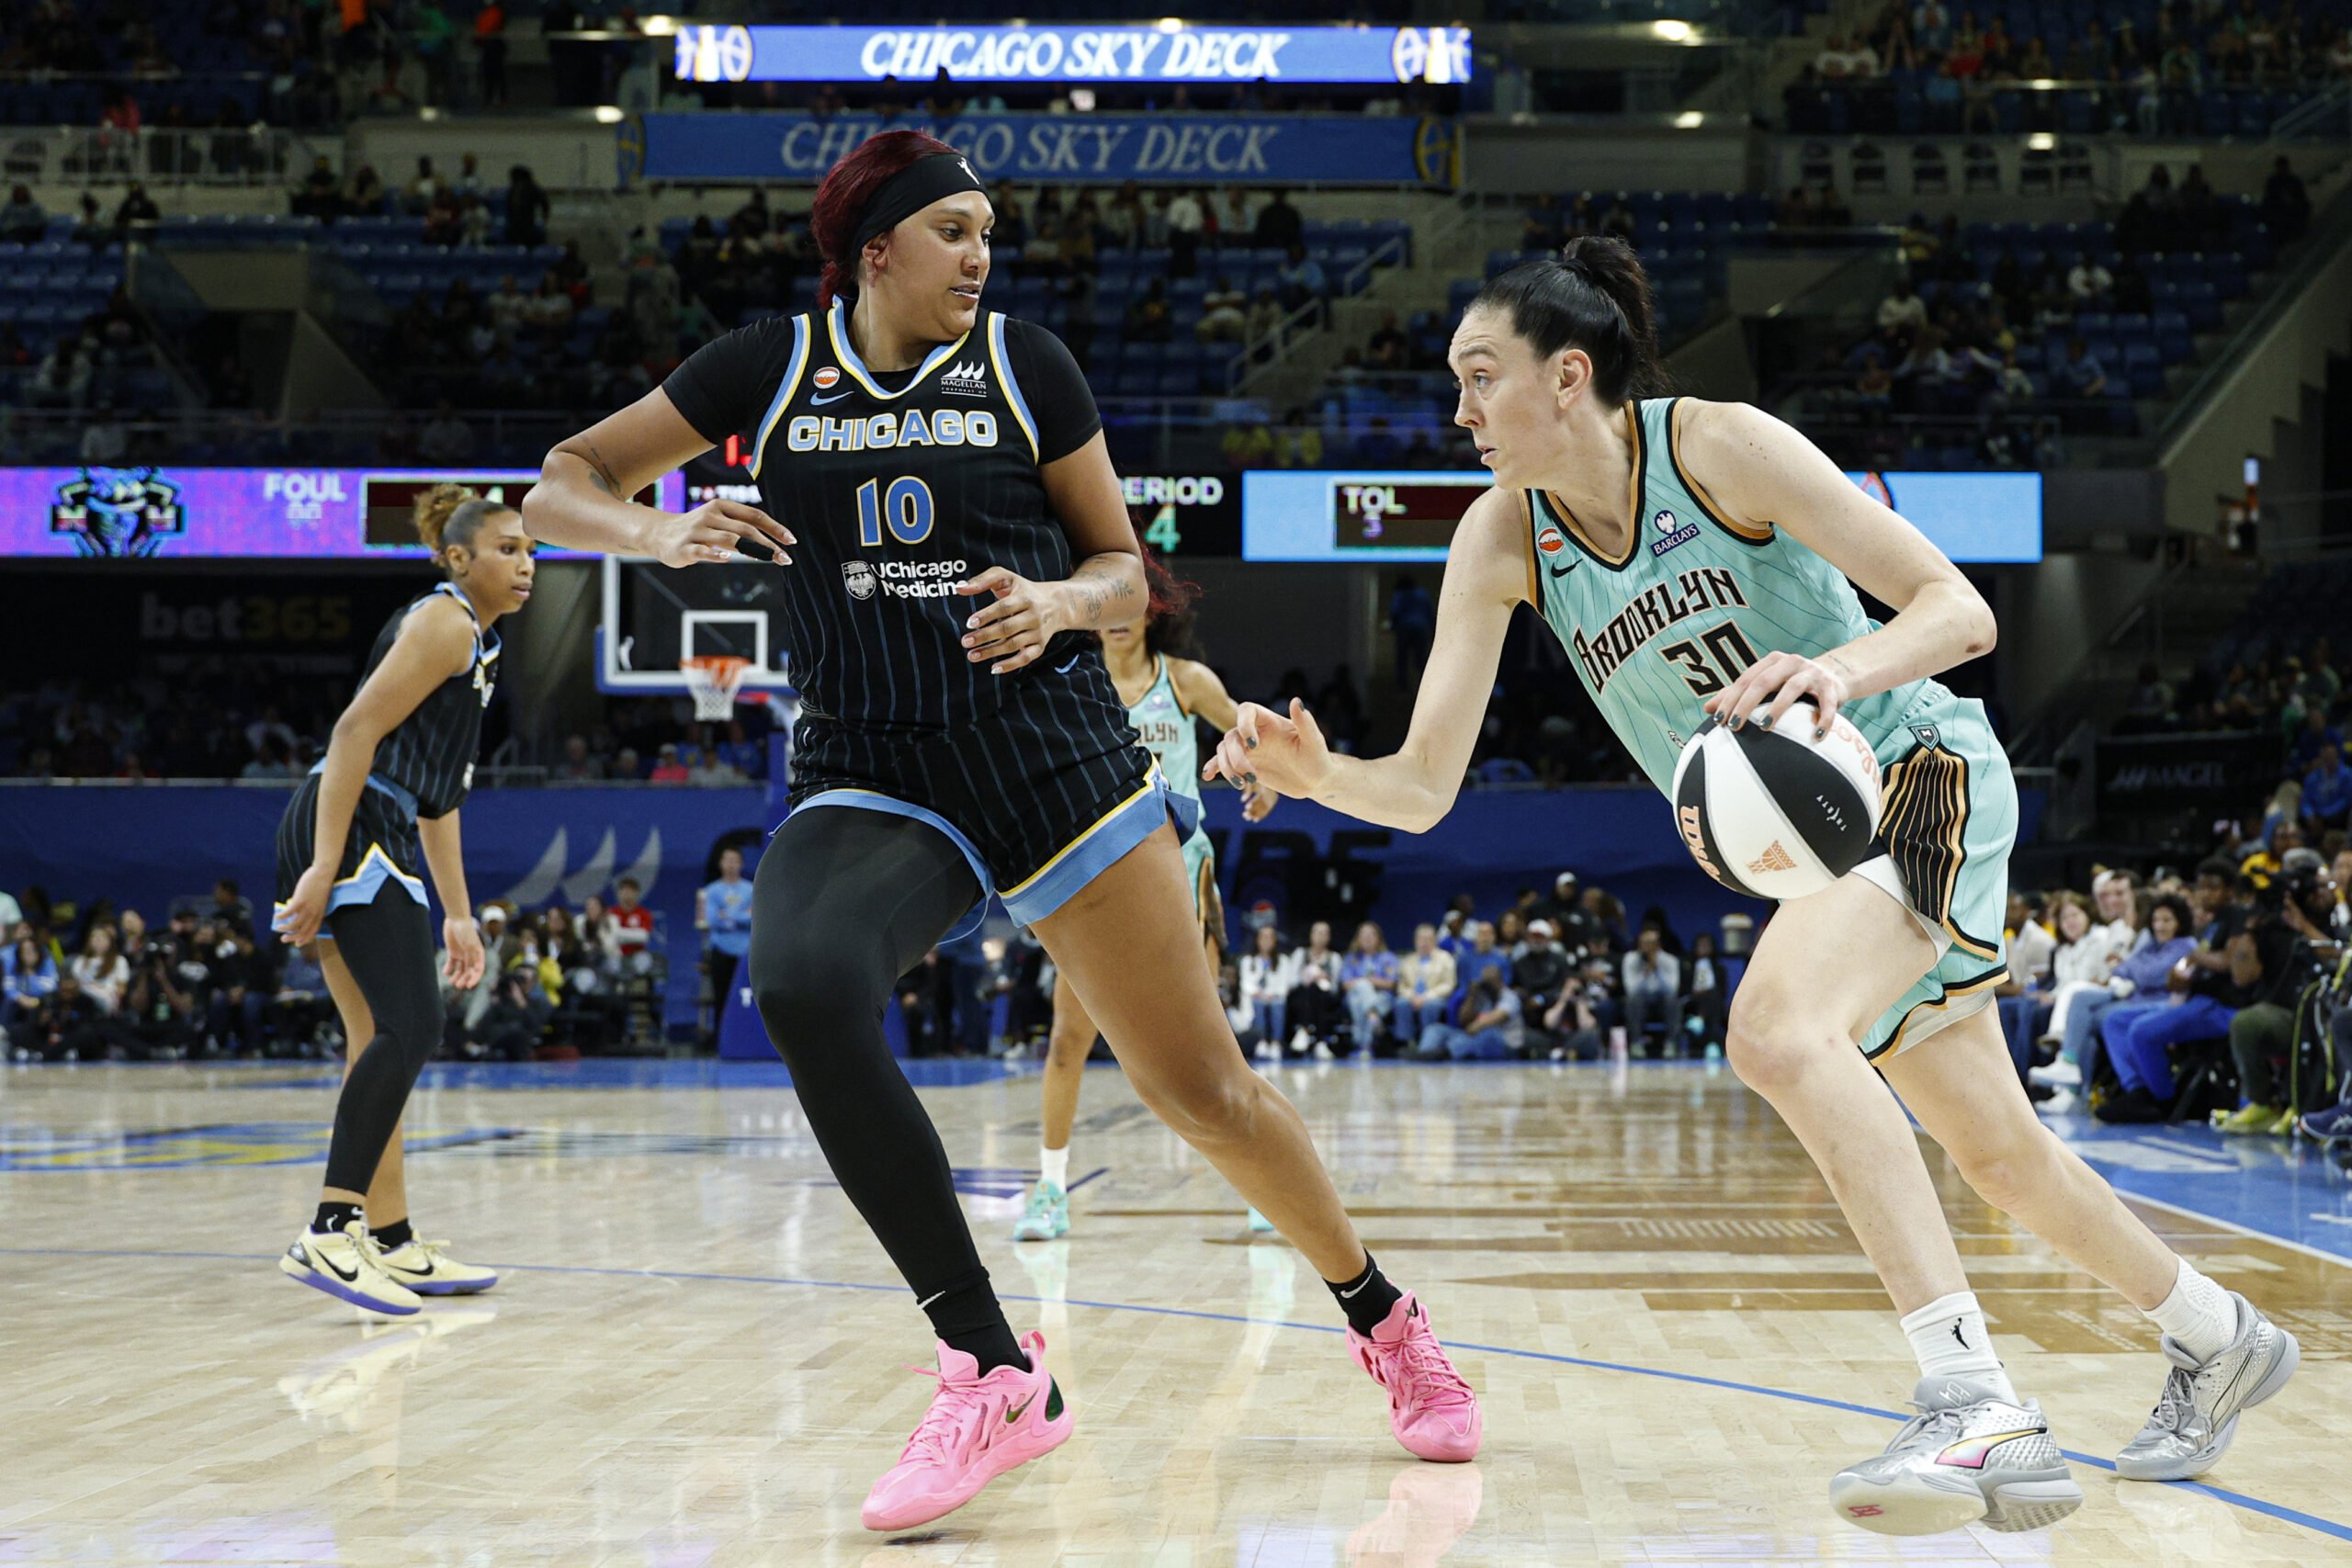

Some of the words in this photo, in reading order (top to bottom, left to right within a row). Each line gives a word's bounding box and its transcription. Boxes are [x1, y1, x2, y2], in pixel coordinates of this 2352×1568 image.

[861, 31, 1064, 77] CHICAGO
[1064, 31, 1163, 77] SKY
[1161, 31, 1291, 77] DECK
[781, 122, 1015, 171] CHGO
[1018, 123, 1130, 172] SKY
[1136, 125, 1281, 173] DECK
[941, 379, 987, 389] MAGELLAN
[787, 409, 998, 452] CHICAGO
[265, 473, 347, 502] FOUL
[1117, 476, 1224, 505] ERIOD
[1341, 486, 1408, 514] TOL
[855, 475, 934, 547] 10
[1145, 504, 1182, 552] 4
[1654, 525, 1698, 556] BARCLAYS
[870, 559, 967, 579] UChicago
[880, 579, 959, 599] Medicin
[140, 592, 352, 641] bet365
[1573, 566, 1750, 698] BROOKLYN
[1657, 618, 1761, 698] 30
